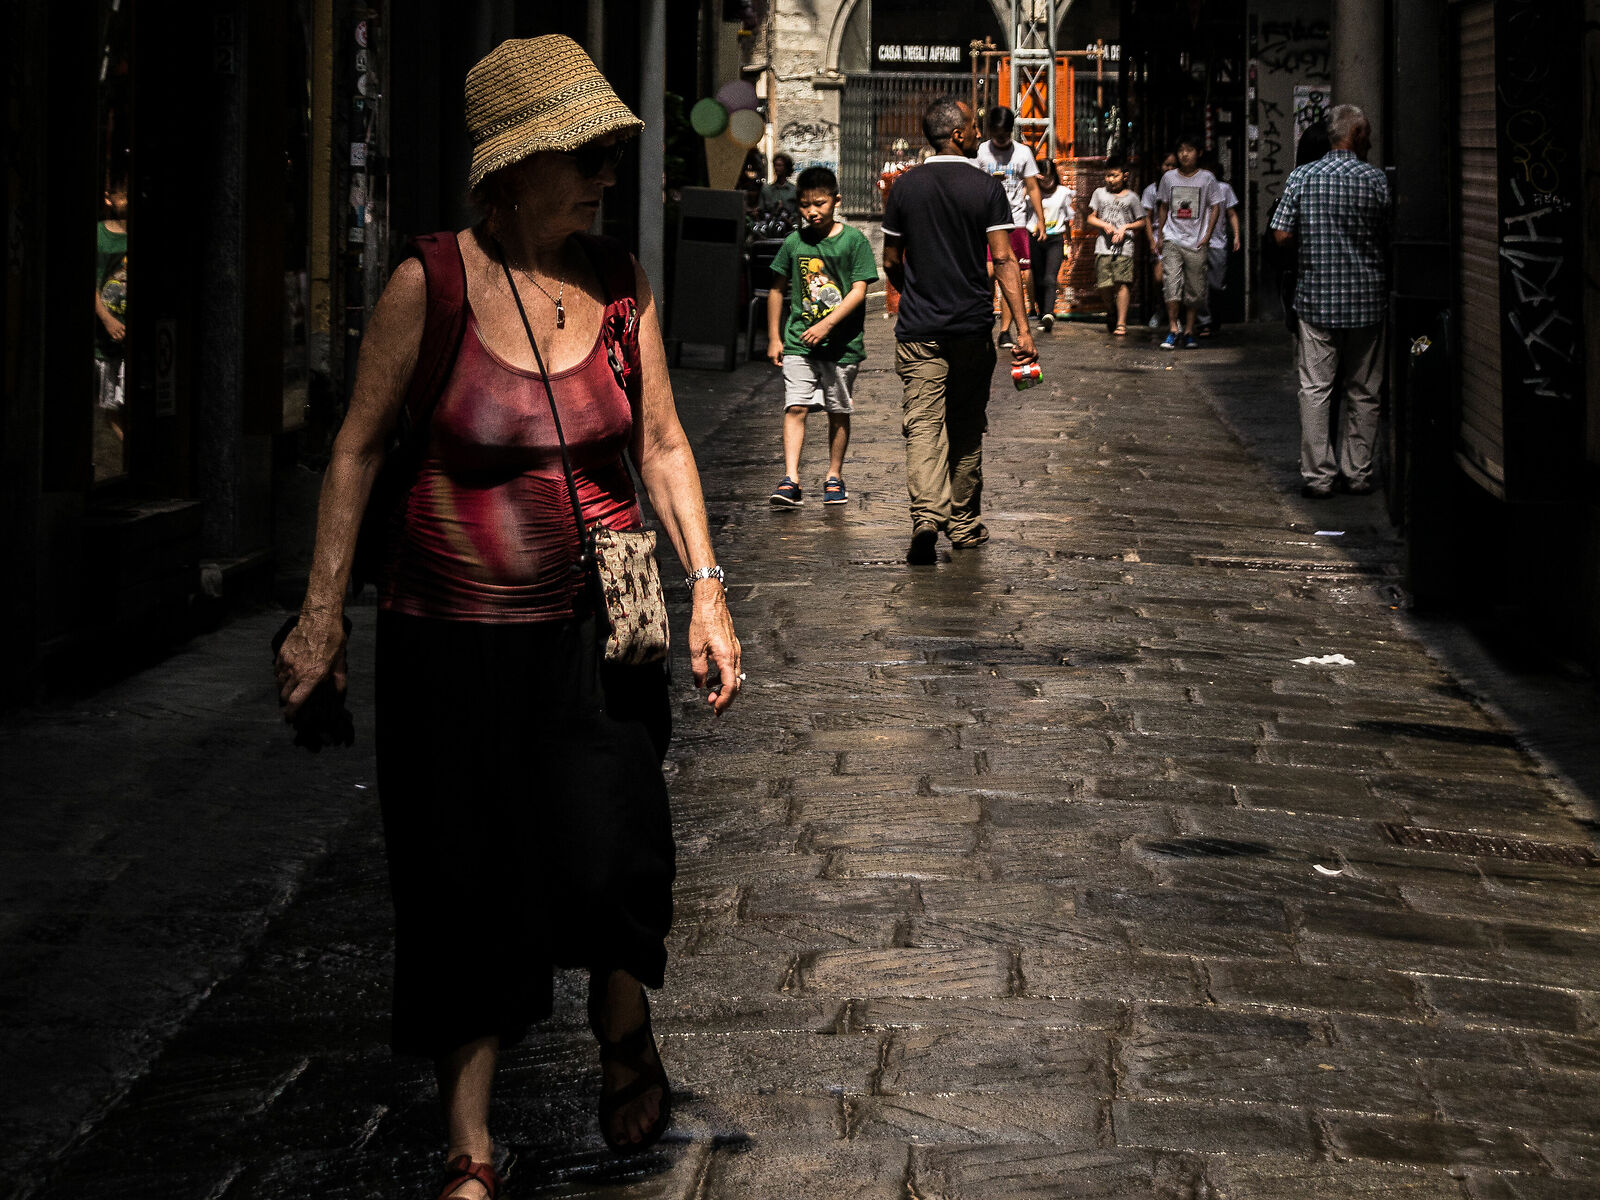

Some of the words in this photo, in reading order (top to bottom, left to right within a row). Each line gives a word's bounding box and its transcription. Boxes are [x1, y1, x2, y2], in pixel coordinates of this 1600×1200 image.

[878, 44, 902, 62] CASA
[902, 45, 929, 62] DEGLI
[929, 45, 961, 63] AFFARI
